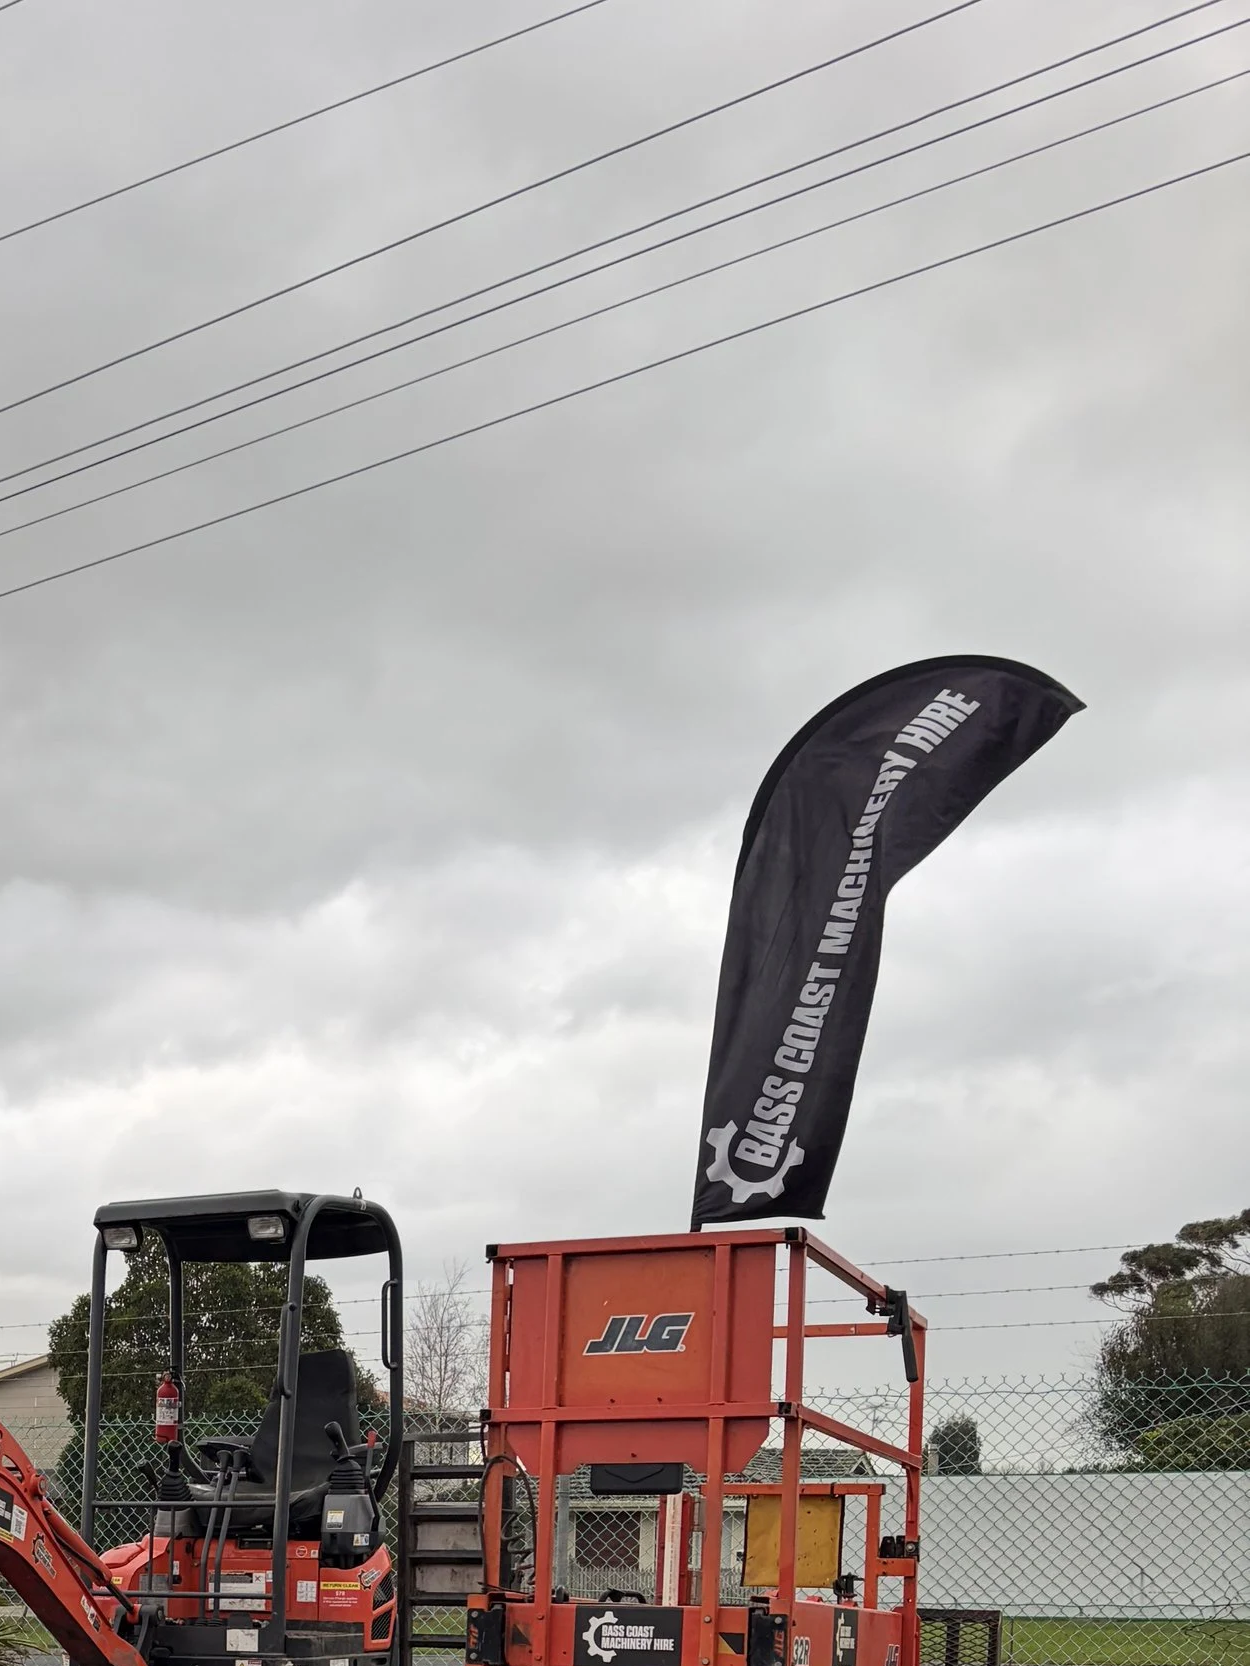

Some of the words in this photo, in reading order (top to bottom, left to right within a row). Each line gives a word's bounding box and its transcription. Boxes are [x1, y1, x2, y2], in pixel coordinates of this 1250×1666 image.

[735, 1075, 805, 1168] BASS
[774, 962, 842, 1073] COAST
[817, 750, 916, 954] MACHINERY
[894, 688, 981, 754] HIRE
[582, 1312, 695, 1355] JLG
[601, 1637, 652, 1650] MACHINERY
[653, 1638, 674, 1651] HIRE
[602, 1625, 625, 1637] BASS
[626, 1625, 655, 1637] COAST
